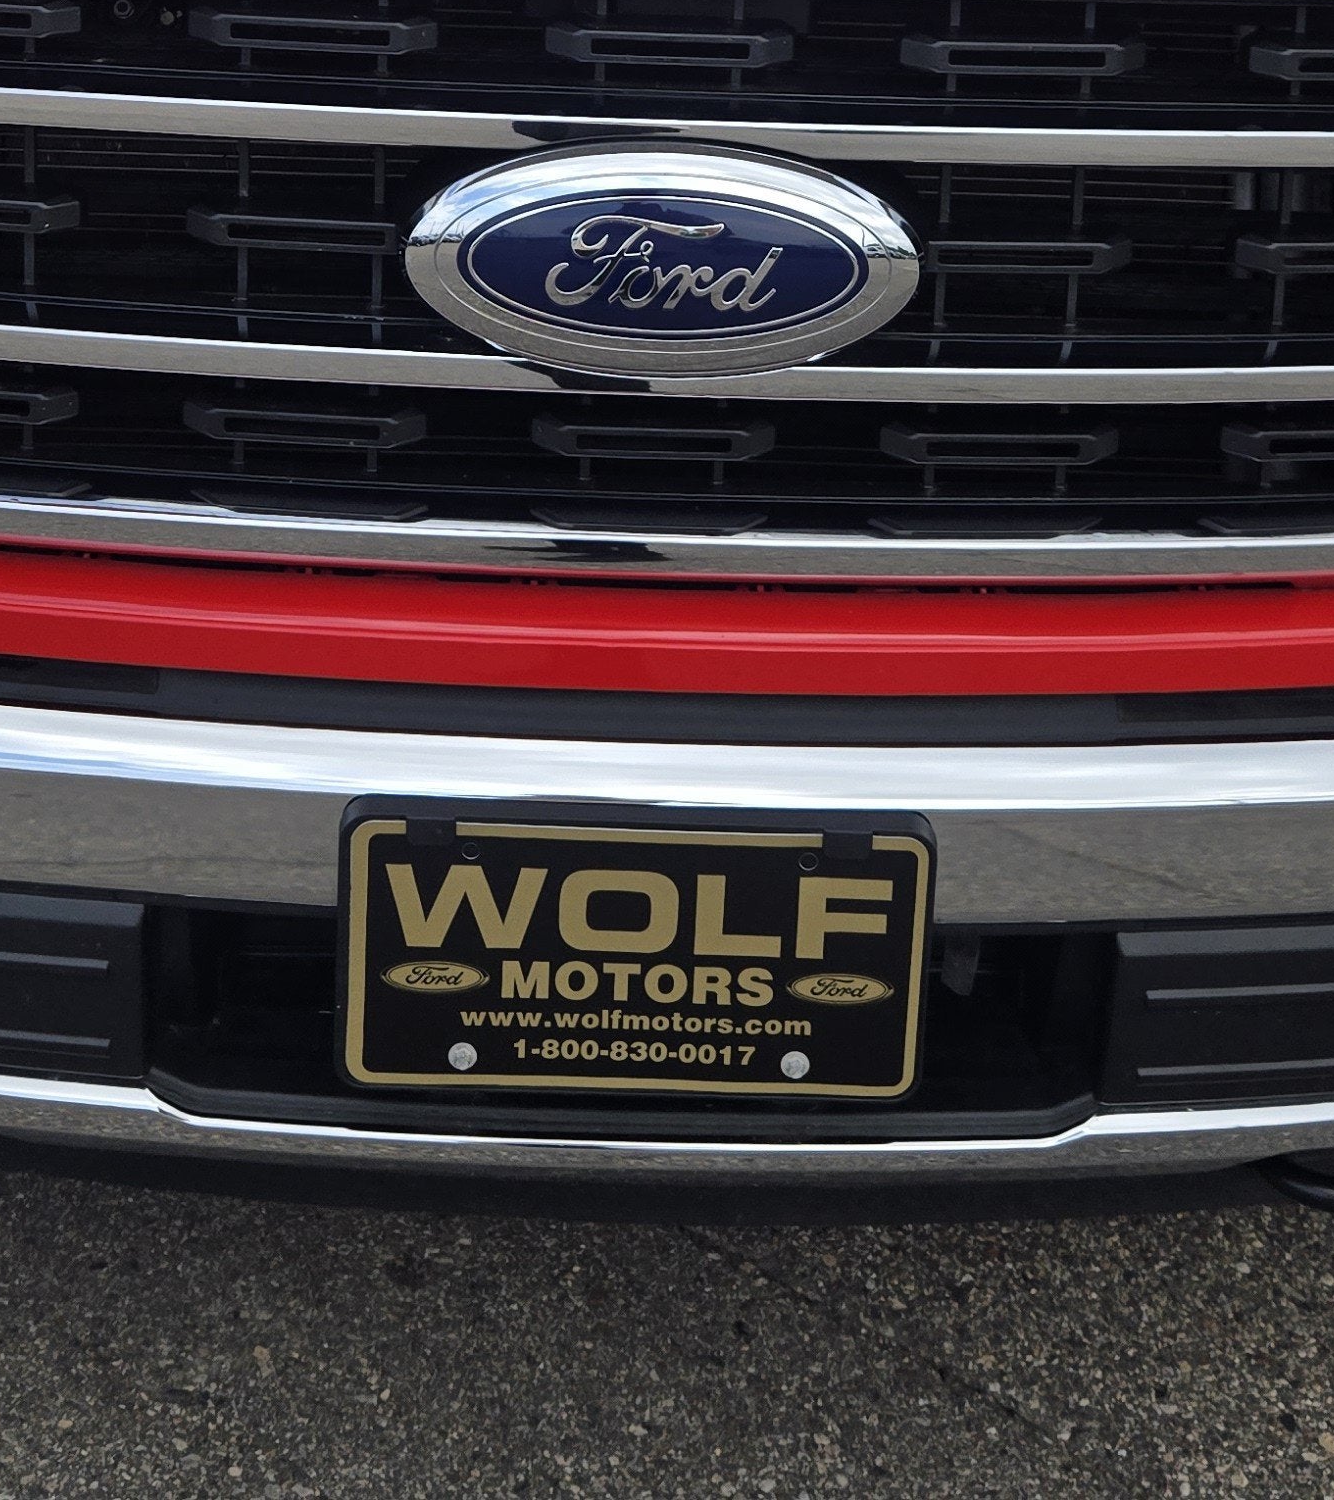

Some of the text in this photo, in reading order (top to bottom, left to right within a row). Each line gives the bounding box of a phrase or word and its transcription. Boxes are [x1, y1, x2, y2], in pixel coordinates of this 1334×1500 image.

[545, 215, 784, 312] Ford
[385, 863, 894, 960] WOLF
[405, 965, 464, 988] Ford
[500, 960, 774, 1007] MOTORS
[809, 977, 869, 998] Ford
[460, 1009, 812, 1036] www.wolfmotors.com
[512, 1038, 756, 1067] 1-800-830-0017
